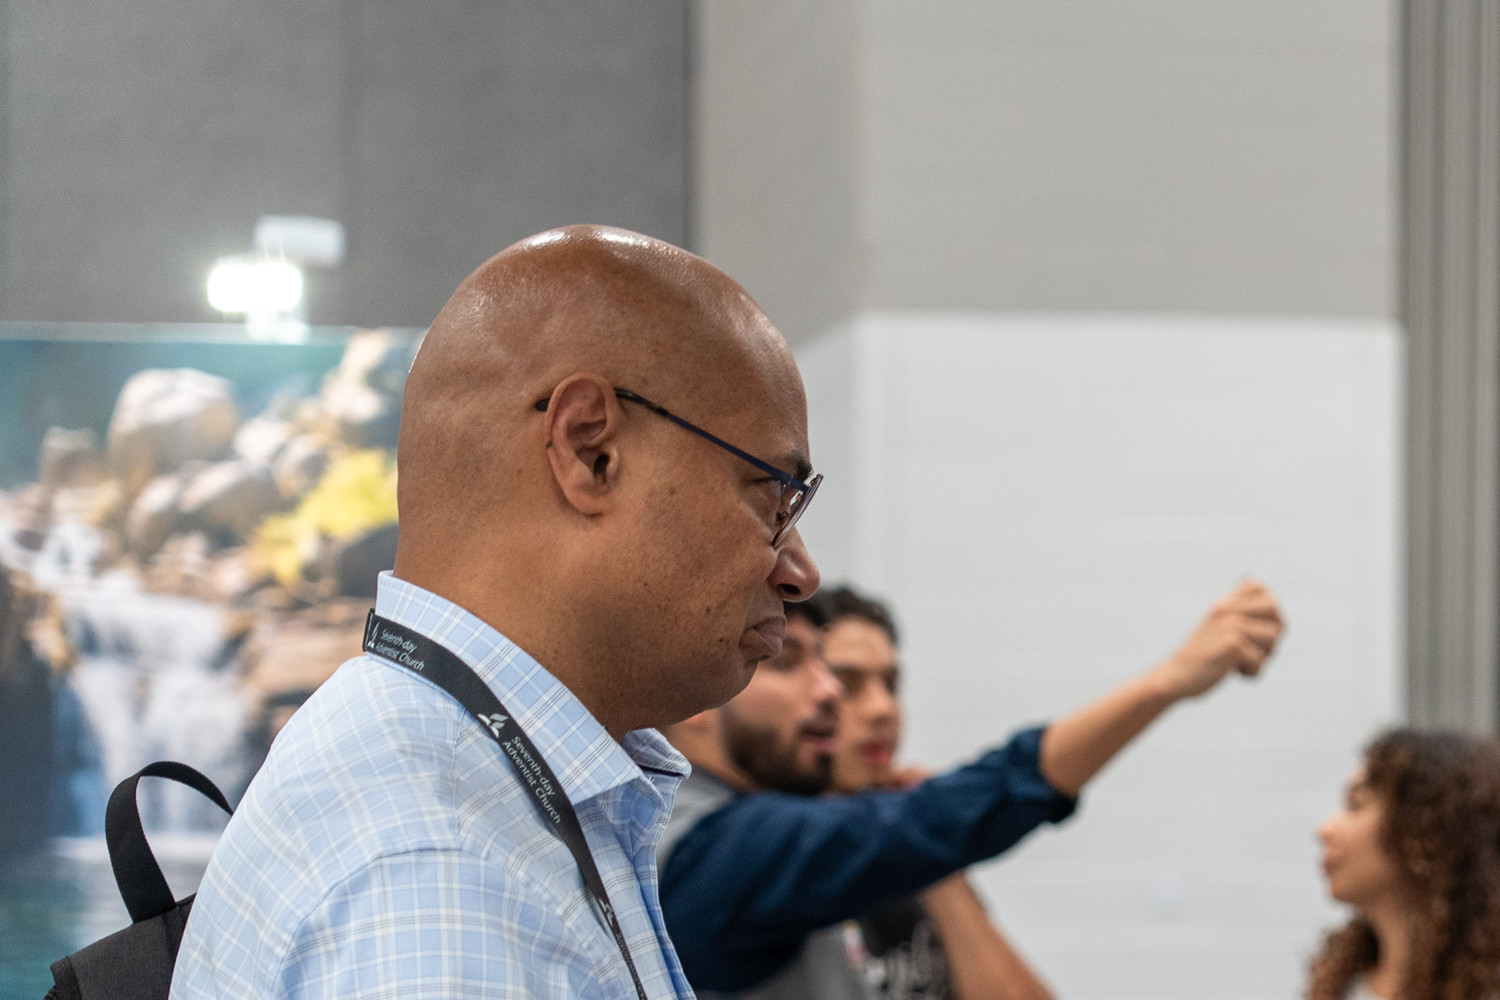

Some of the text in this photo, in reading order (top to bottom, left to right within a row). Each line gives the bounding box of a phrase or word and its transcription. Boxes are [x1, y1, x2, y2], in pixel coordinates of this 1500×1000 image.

[399, 652, 425, 671] Church
[502, 741, 561, 824] Adventist Church
[512, 736, 556, 796] Seventh-day
